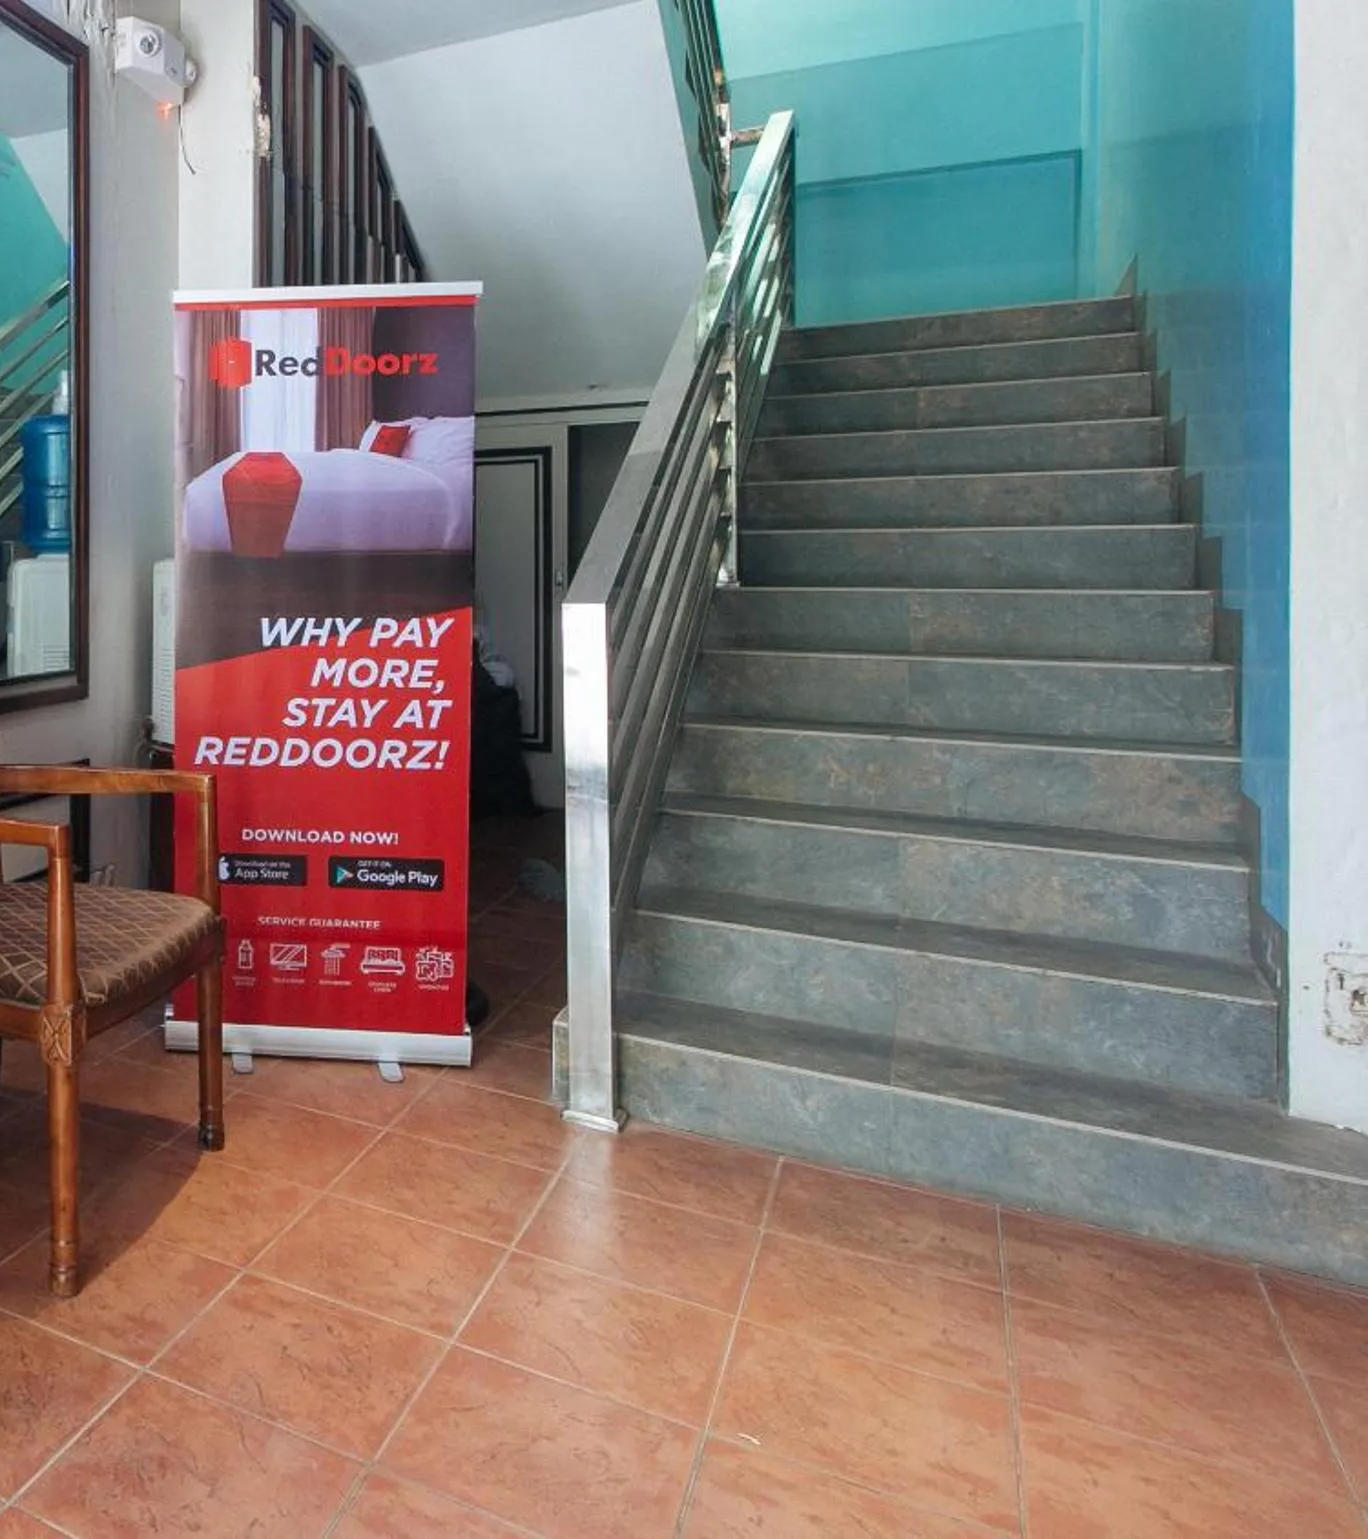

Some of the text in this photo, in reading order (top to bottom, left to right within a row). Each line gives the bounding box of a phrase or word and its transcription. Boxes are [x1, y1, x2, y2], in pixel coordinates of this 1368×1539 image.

[255, 346, 438, 377] RedDoorz
[260, 617, 455, 648] WHY PAY
[311, 658, 445, 694] MORE,
[282, 698, 453, 729] STAY AT
[194, 736, 450, 770] REDDOORZ!
[241, 828, 399, 845] DOWNLOAD NOW!
[235, 867, 289, 880] App Store
[357, 869, 438, 887] Google Play
[257, 917, 381, 930] SERVICE GUARANTEE
